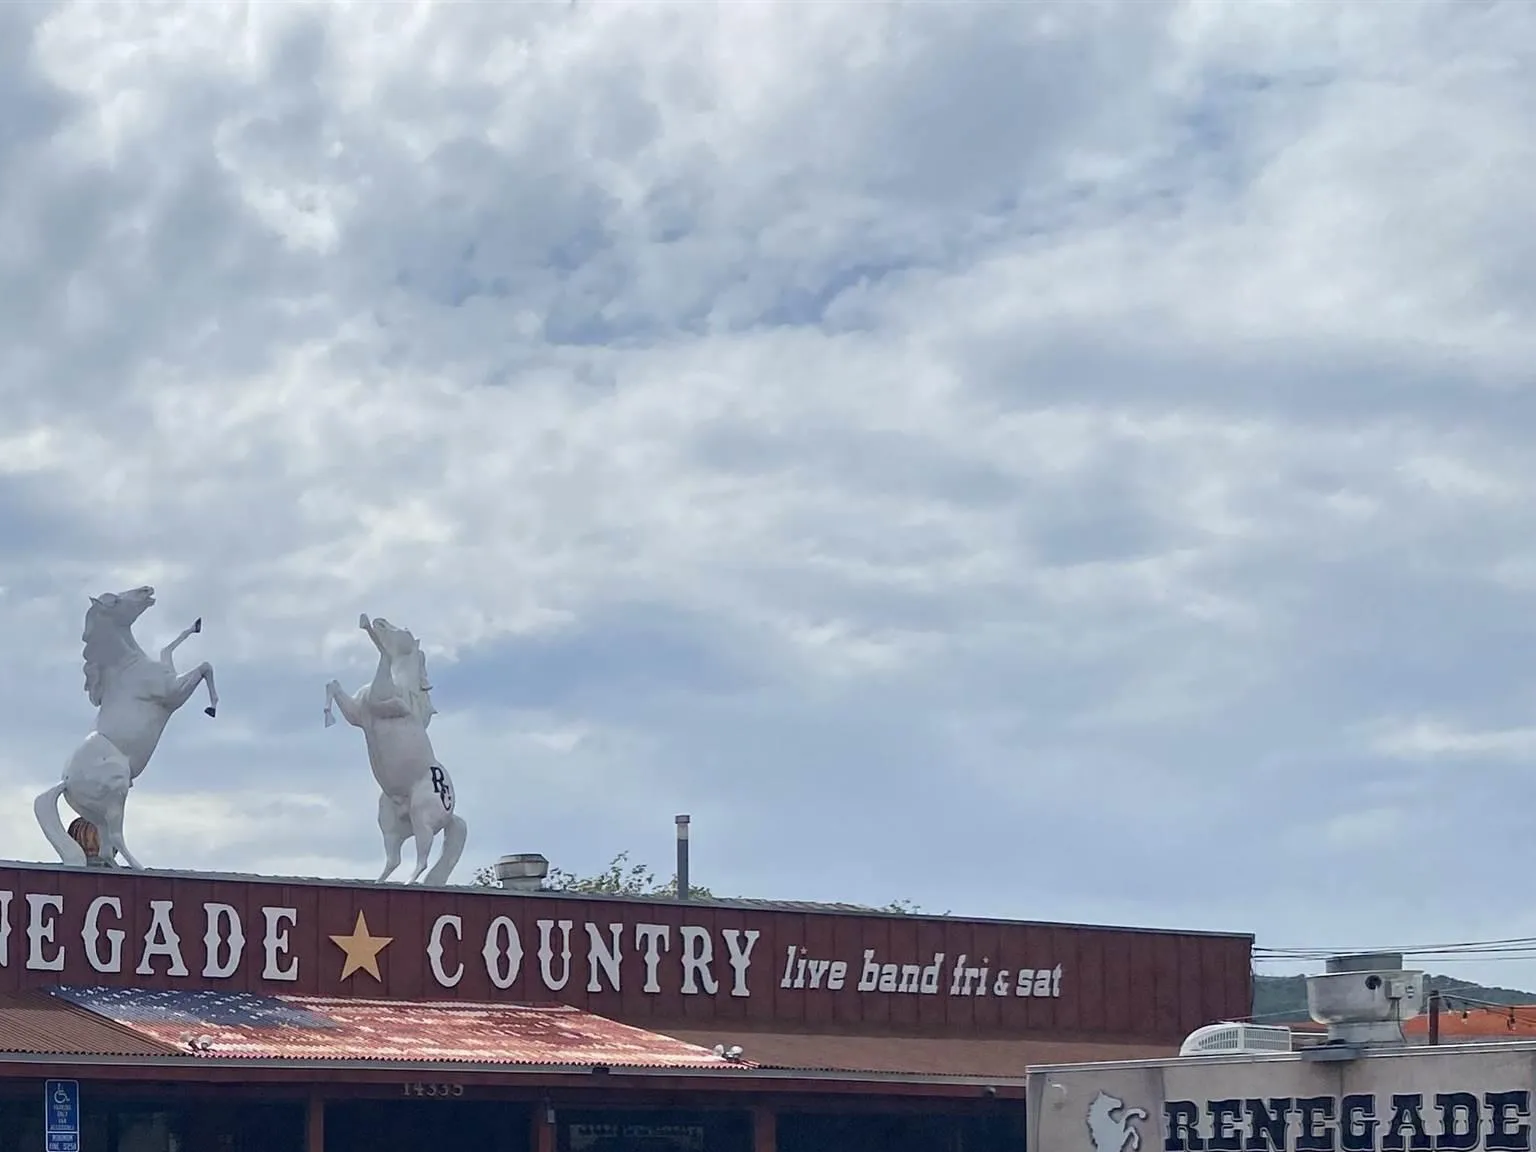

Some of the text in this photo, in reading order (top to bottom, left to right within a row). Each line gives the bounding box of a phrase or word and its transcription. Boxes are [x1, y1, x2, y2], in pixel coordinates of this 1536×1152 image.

[426, 914, 761, 997] COUNTRY
[780, 945, 1063, 998] live band fri & sat
